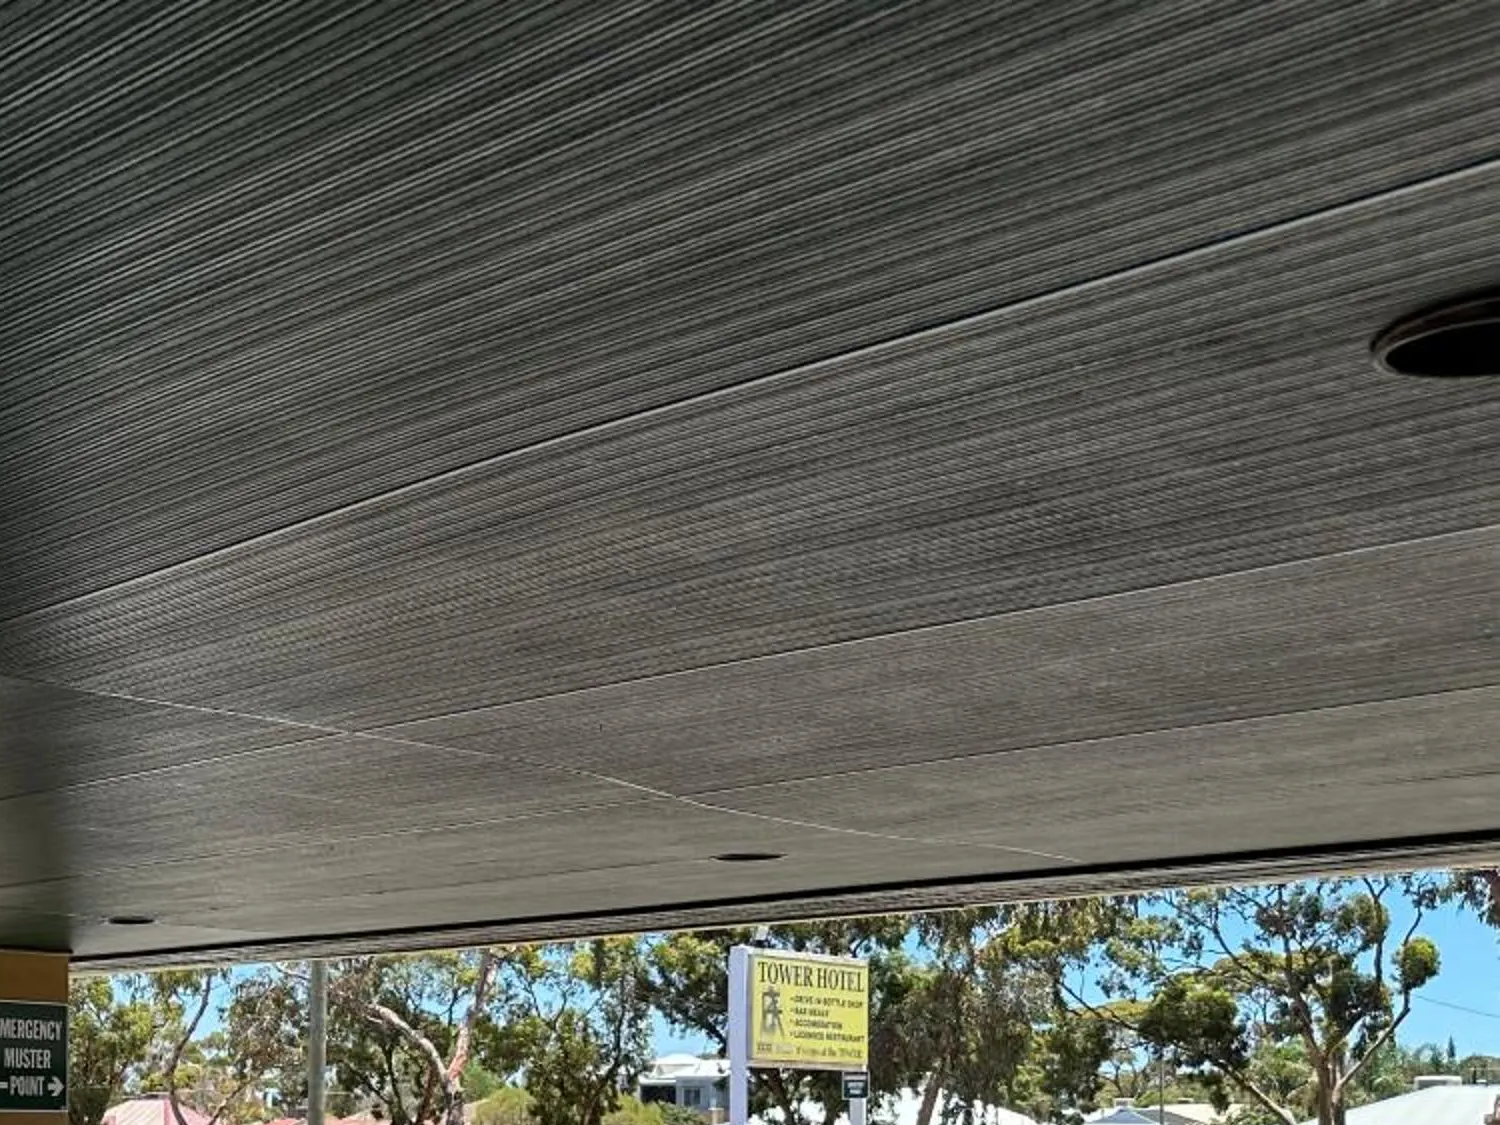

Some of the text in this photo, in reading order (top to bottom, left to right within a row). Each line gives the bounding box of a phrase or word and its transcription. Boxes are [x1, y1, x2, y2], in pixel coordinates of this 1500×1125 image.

[758, 961, 864, 992] TOWER HOTEL
[4, 1047, 51, 1069] MUSTER
[10, 1075, 45, 1096] POINT
